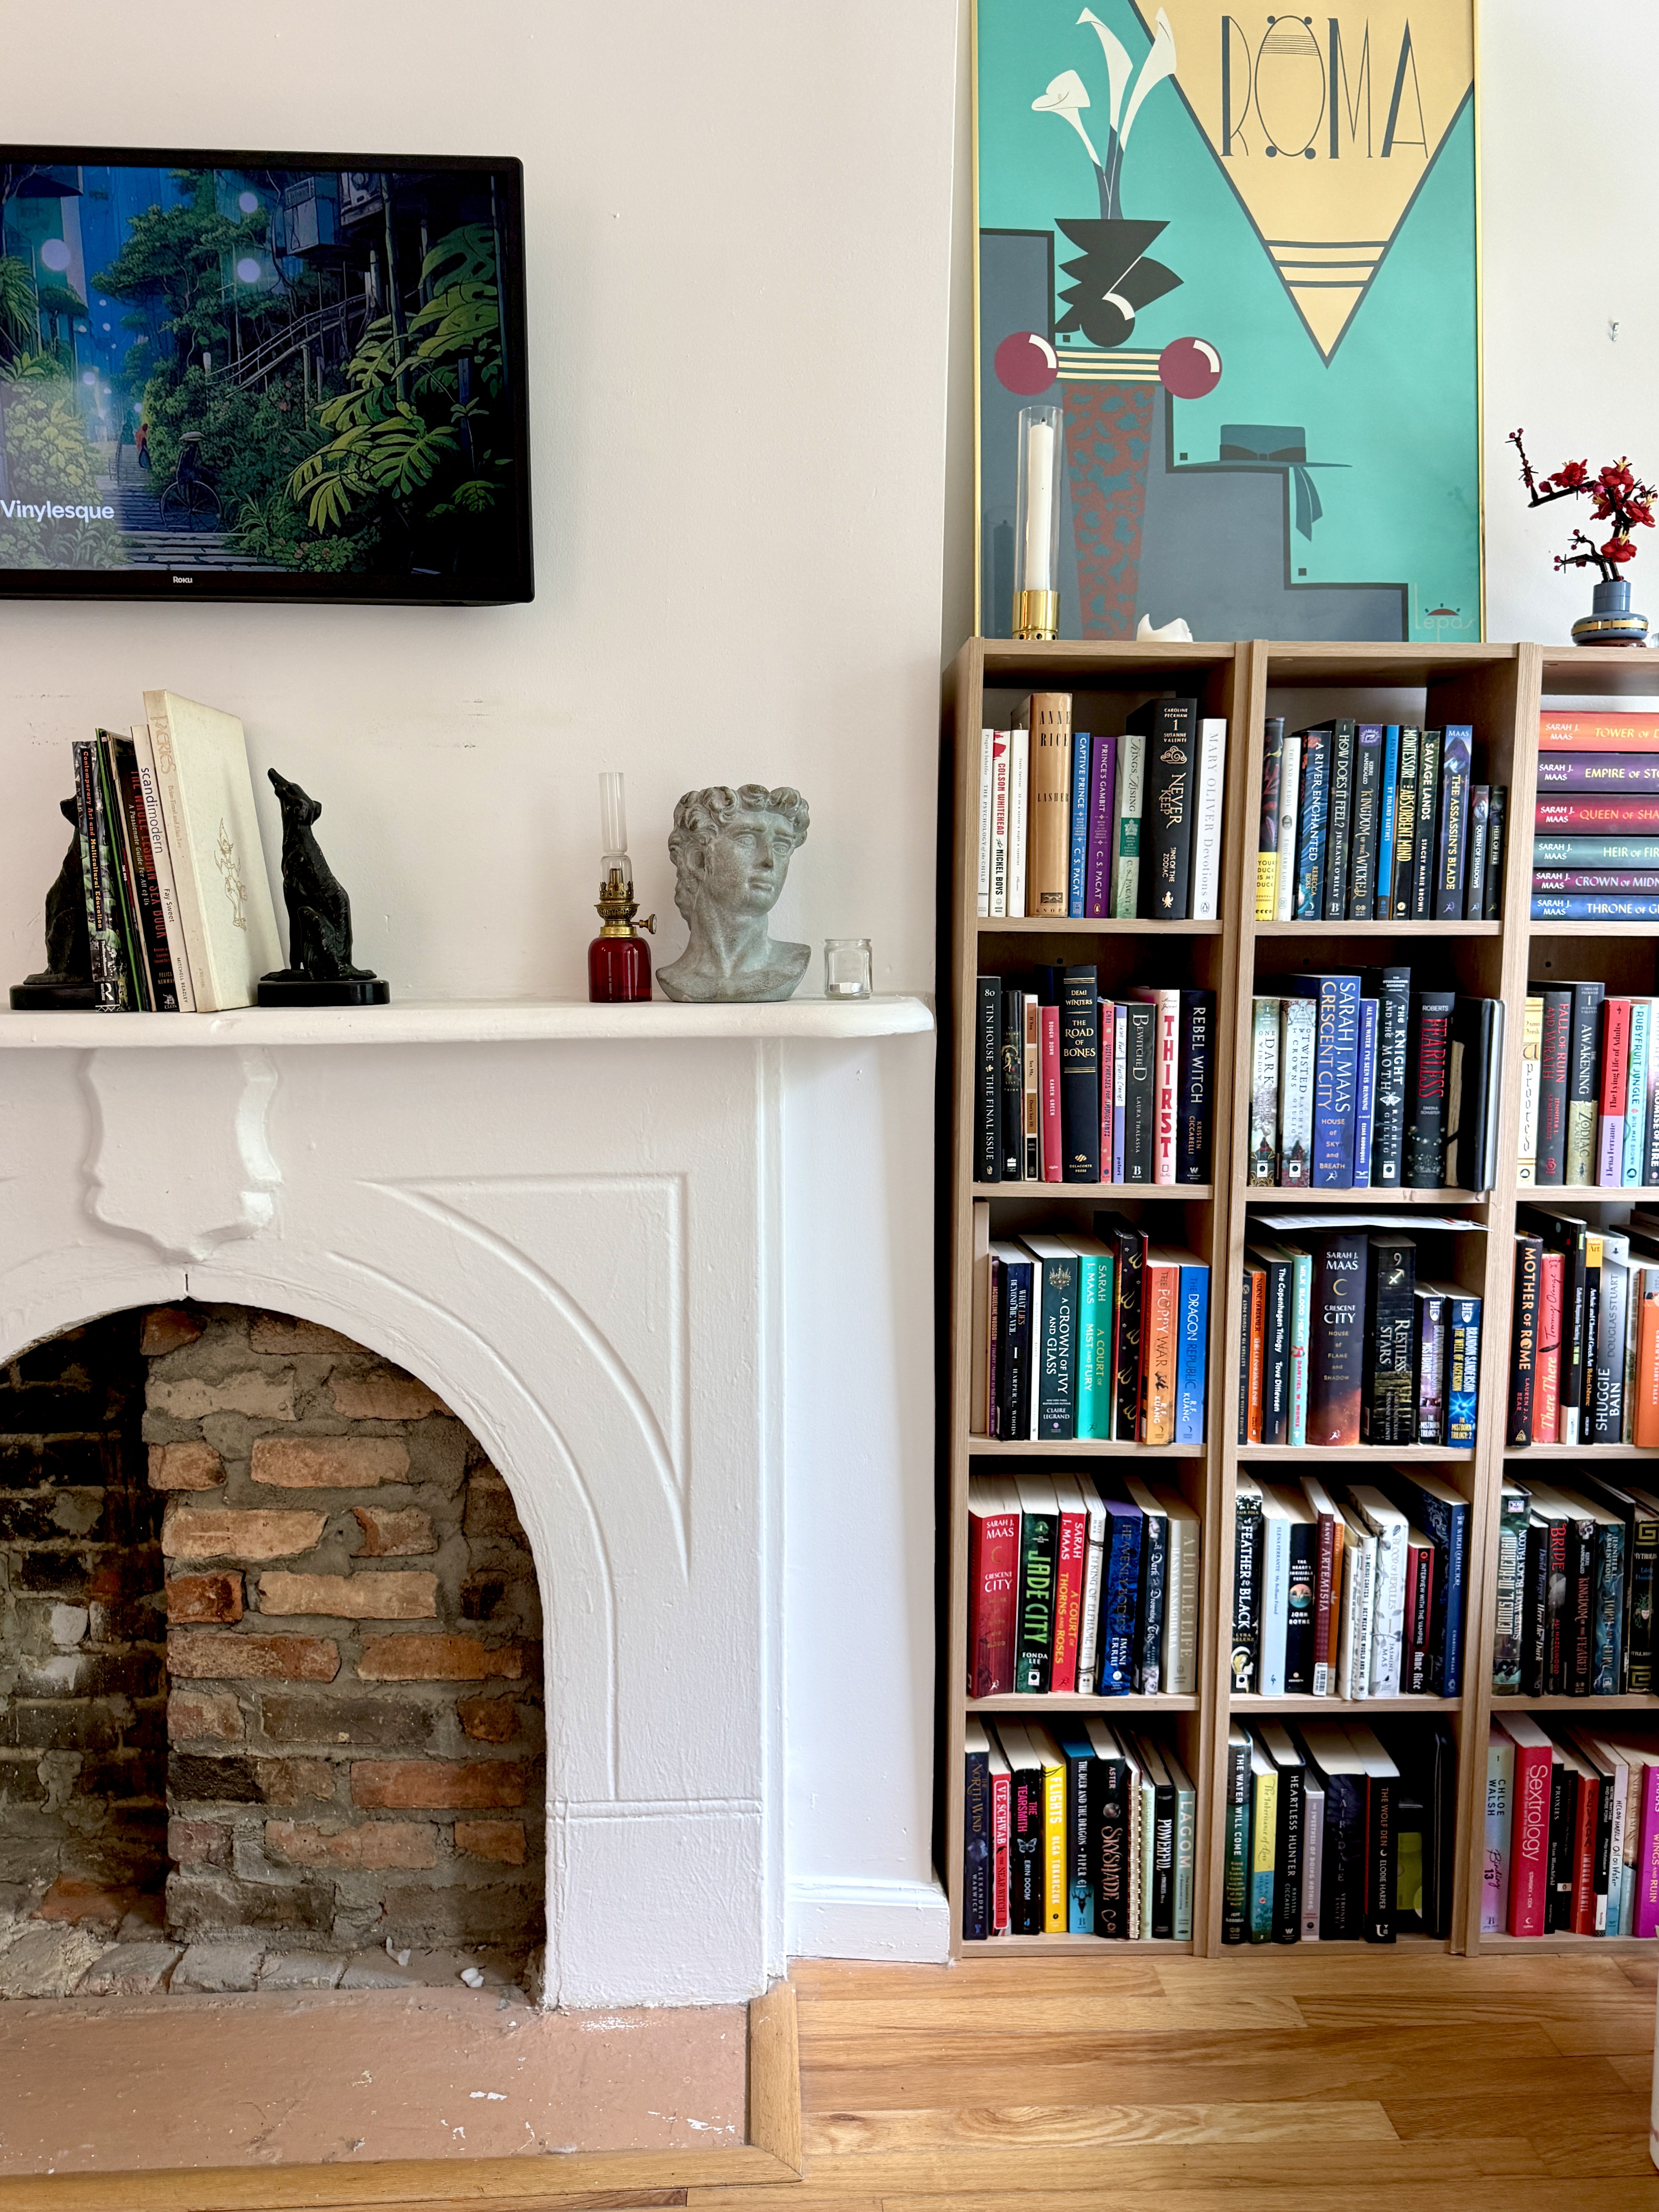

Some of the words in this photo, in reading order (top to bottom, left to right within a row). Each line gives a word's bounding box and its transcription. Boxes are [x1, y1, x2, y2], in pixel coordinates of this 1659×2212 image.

[1220, 15, 1429, 159] ROMA
[0, 499, 115, 522] Vinylesque
[1315, 742, 1324, 750] A
[1338, 735, 1349, 757] HOW
[1595, 728, 1634, 737] TOWER
[1207, 733, 1218, 771] MARY
[1423, 742, 1434, 785] SAVAGE
[84, 751, 92, 805] Contemporary
[997, 763, 1006, 791] COLSON
[1312, 754, 1323, 789] RIVER
[1337, 760, 1348, 788] DOES
[1451, 775, 1460, 796] THE
[141, 768, 164, 853] scandimodern
[1159, 790, 1171, 815] KEEP
[1166, 773, 1186, 829] NEVER
[1205, 778, 1216, 831] OLIVER
[1336, 790, 1348, 799] IT
[1421, 788, 1432, 820] LANDS
[997, 794, 1005, 835] WHITEHEAD
[1309, 790, 1320, 861] ENCHANTED
[1334, 800, 1345, 828] FEEL?
[1448, 798, 1459, 854] ASSASSIN'S
[995, 838, 1004, 848] The
[995, 849, 1004, 874] NICKEL
[91, 838, 100, 888] Multicultural
[1169, 860, 1176, 869] OF
[1201, 839, 1213, 896] Devotions
[1446, 857, 1456, 890] BLADE
[995, 877, 1004, 895] BOYS
[1575, 877, 1618, 887] CROWN
[95, 891, 103, 929] Education
[166, 903, 175, 922] Sweet
[1587, 904, 1632, 913] THRONE
[177, 957, 185, 980] MITCHELL
[180, 981, 188, 1003] BEAZLEY
[1191, 1007, 1205, 1050] REBEL
[1319, 981, 1337, 1067] CRESCENT
[1337, 982, 1356, 1041] SARAH
[1546, 1007, 1555, 1026] AND
[1557, 1004, 1569, 1033] FALL
[985, 1026, 993, 1061] HOUSE
[1334, 1047, 1352, 1055] J.
[1543, 1031, 1555, 1079] WRATH
[1559, 1037, 1566, 1048] OF
[1633, 1011, 1644, 1065] RUBYFRUIT
[1418, 1017, 1447, 1098] FEARLESS
[1556, 1052, 1568, 1082] RUIN
[1579, 1024, 1592, 1094] AWAKENING
[986, 1075, 994, 1096] THE
[1160, 1015, 1175, 1158] THIRST
[1190, 1056, 1204, 1103] WITCH
[1318, 1071, 1332, 1110] CITY
[1335, 1061, 1351, 1112] MAAS
[1632, 1068, 1640, 1104] JUNGLE
[985, 1099, 994, 1129] FINAL
[986, 1132, 994, 1160] ISSUE
[1522, 1247, 1536, 1309] MOTHER
[1187, 1294, 1199, 1340] DRAGON
[1276, 1283, 1285, 1327] Copenhagen
[1523, 1314, 1531, 1326] OF
[1058, 1305, 1069, 1356] CROWN
[1274, 1328, 1283, 1352] Trilogy
[1379, 1327, 1391, 1364] STARS
[1393, 1320, 1410, 1372] RESTLESS
[1047, 1338, 1056, 1374] GLASS
[1060, 1360, 1067, 1370] OF
[1185, 1344, 1197, 1389] REPUBLIC
[1519, 1330, 1532, 1370] ROME
[1057, 1373, 1068, 1394] IVY
[1596, 1368, 1609, 1431] SHUGGIE
[1610, 1383, 1620, 1416] BAIN
[1551, 1523, 1566, 1571] BRIDE
[1026, 1550, 1051, 1599] JADE
[1319, 1548, 1330, 1611] ARTEMISIA
[1024, 1603, 1049, 1644] CITY
[1414, 1652, 1424, 1671] Anne
[1413, 1673, 1423, 1689] Rice
[1018, 1785, 1027, 1832] TEARSMITH
[1050, 1777, 1062, 1823] FLIGHTS
[1289, 1776, 1298, 1830] HEARTLESS
[1488, 1780, 1496, 1816] WALSH
[1497, 1779, 1505, 1816] CHLOE
[1523, 1765, 1547, 1861] Sextrology
[1052, 1835, 1060, 1855] OLGA
[1156, 1819, 1172, 1870] POWERFUL
[1180, 1801, 1192, 1868] LAGOM
[1101, 1826, 1123, 1900] SKYSHADE
[1288, 1835, 1296, 1876] HUNTER
[1485, 1869, 1494, 1879] 13
[1052, 1859, 1060, 1904] TOKARCZUK
